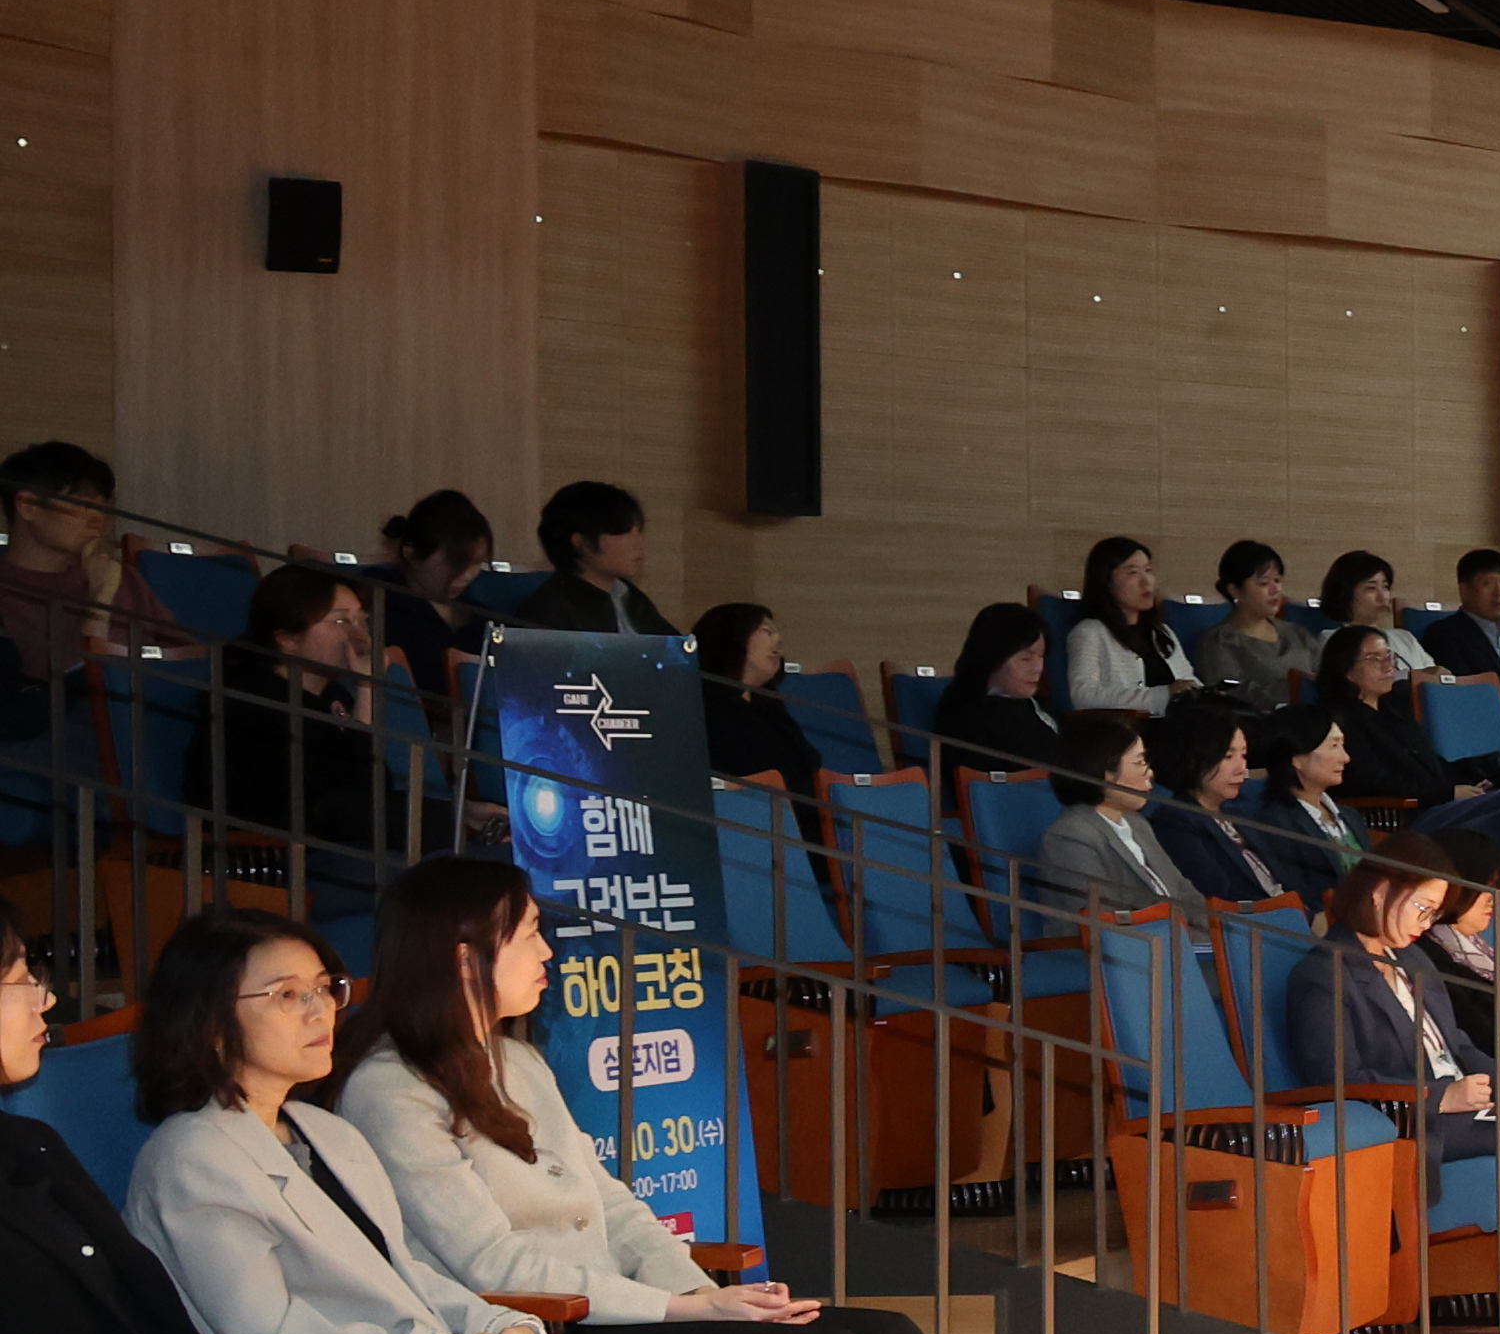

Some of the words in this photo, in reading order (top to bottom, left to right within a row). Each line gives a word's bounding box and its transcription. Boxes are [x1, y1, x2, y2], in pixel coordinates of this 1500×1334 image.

[580, 795, 655, 857] 함께
[553, 872, 697, 938] 그려보는
[559, 948, 705, 1018] 하이코칭
